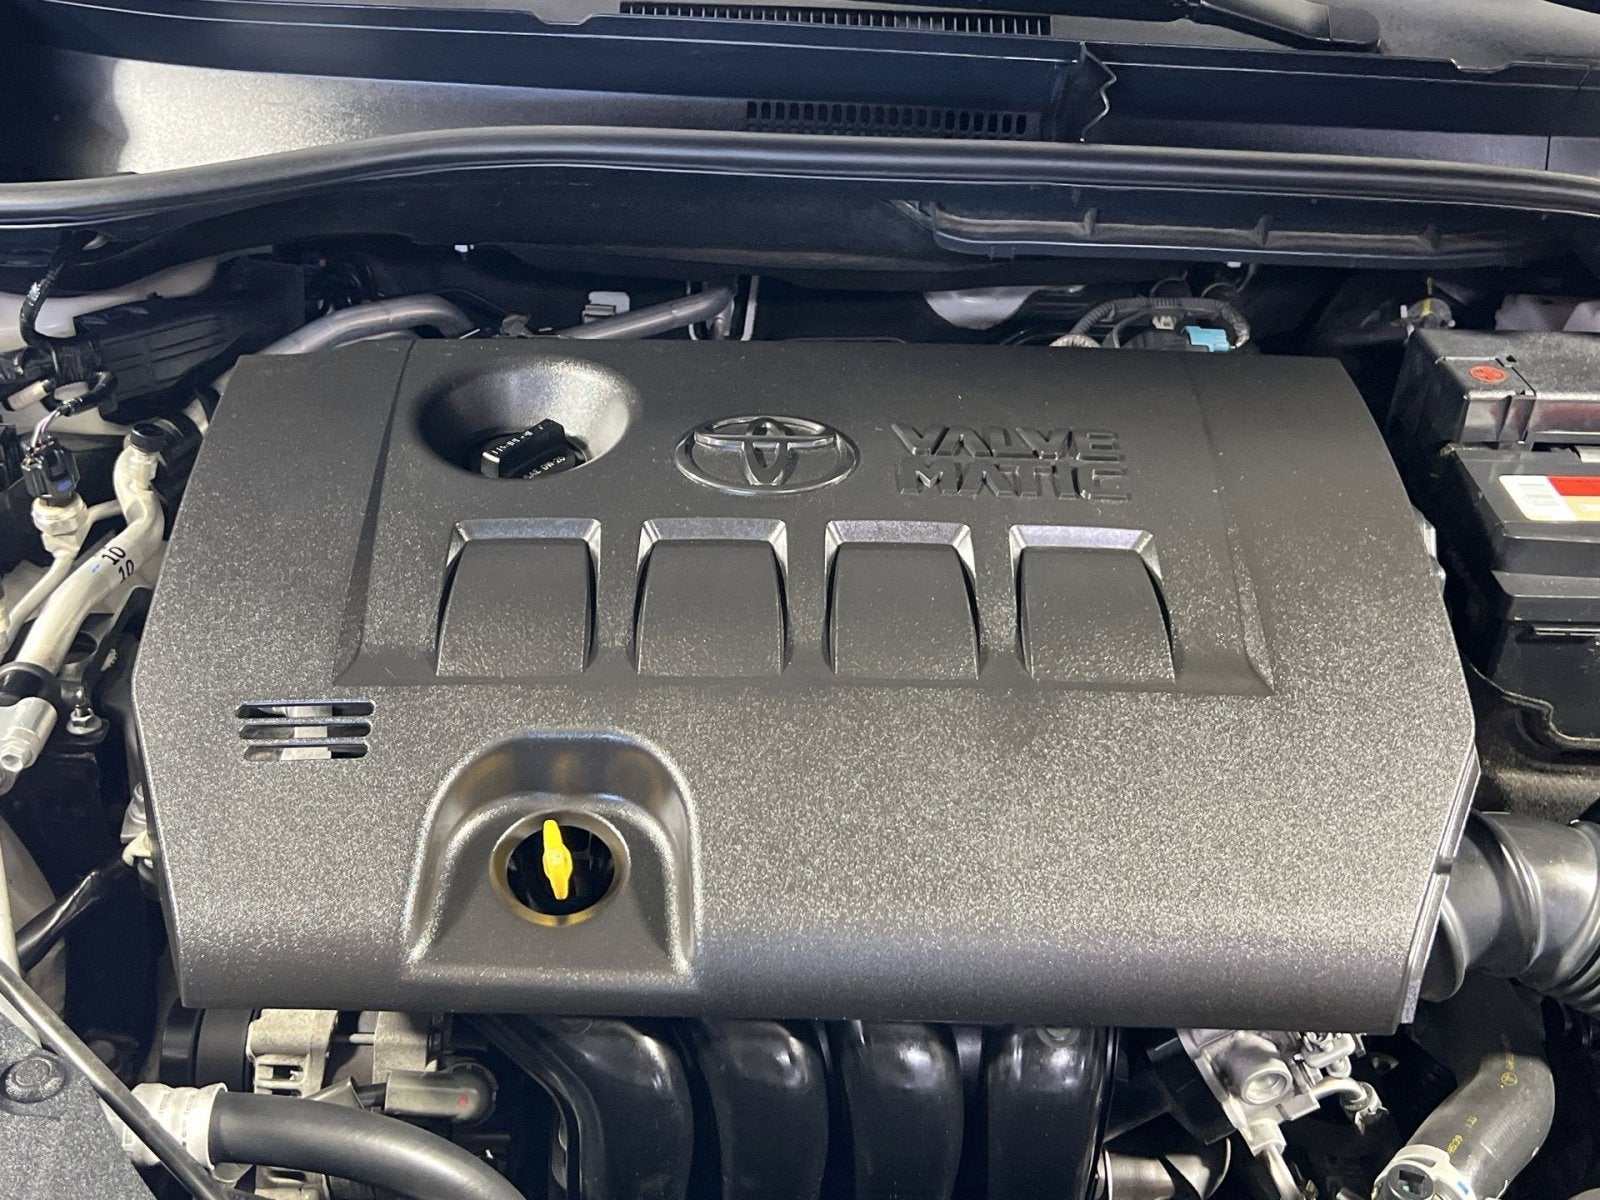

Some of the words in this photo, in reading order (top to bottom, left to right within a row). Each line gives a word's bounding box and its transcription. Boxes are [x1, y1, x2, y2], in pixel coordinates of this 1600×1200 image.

[891, 423, 1126, 461] VALVE
[895, 461, 1131, 501] MATIC
[102, 547, 126, 565] 10
[118, 559, 134, 584] 10
